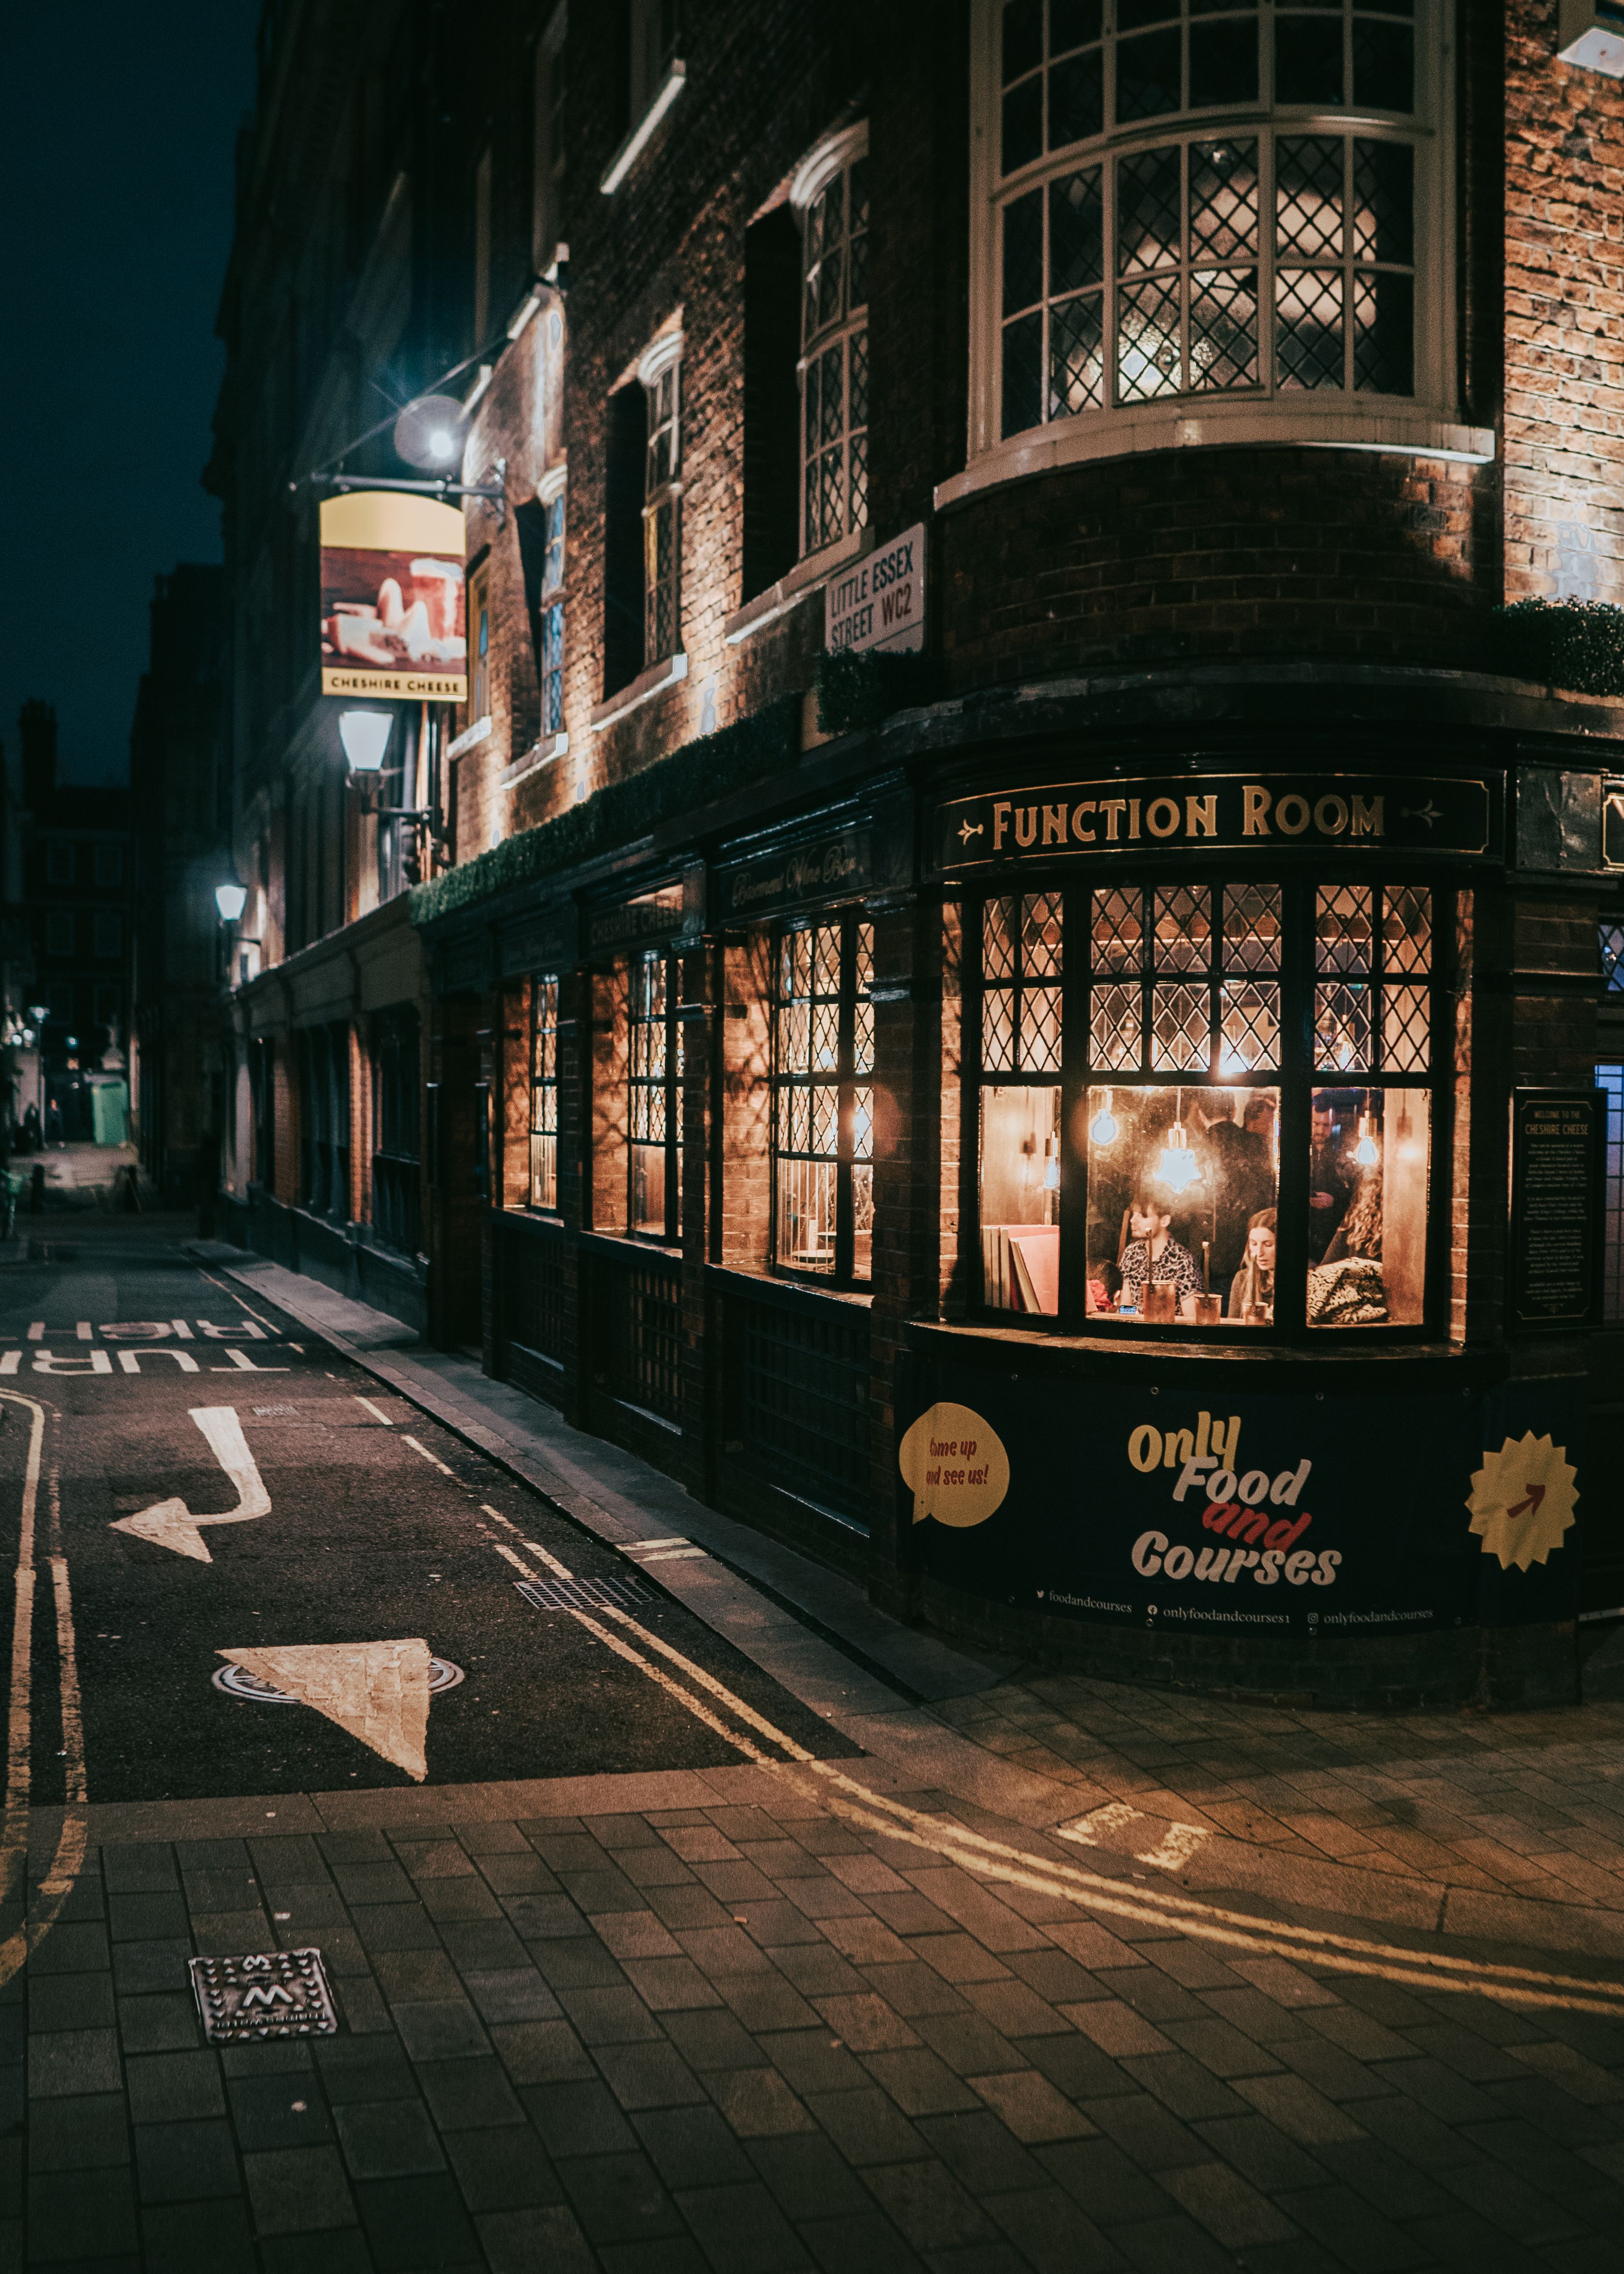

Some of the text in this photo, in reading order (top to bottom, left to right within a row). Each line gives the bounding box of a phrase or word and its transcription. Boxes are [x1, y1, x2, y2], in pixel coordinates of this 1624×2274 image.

[831, 542, 913, 617] LITTLE ESSEX
[832, 584, 912, 649] STREET WC2
[331, 677, 459, 693] CHESHIRE CHEESE
[993, 785, 1385, 849] FUNCTION ROOM
[1525, 1124, 1588, 1135] CHESHIRE CHEESE
[961, 1441, 977, 1460] up
[1128, 1410, 1242, 1473] Only
[943, 1470, 965, 1485] see
[968, 1464, 989, 1485] us!
[1173, 1455, 1312, 1503] Food
[1201, 1502, 1312, 1553] and
[1131, 1530, 1342, 1585] Courses
[1049, 1591, 1132, 1613] foodandcourses
[1163, 1607, 1290, 1624] onlyfoodandcourses1
[1323, 1609, 1433, 1626] onlyfoodandcourses
